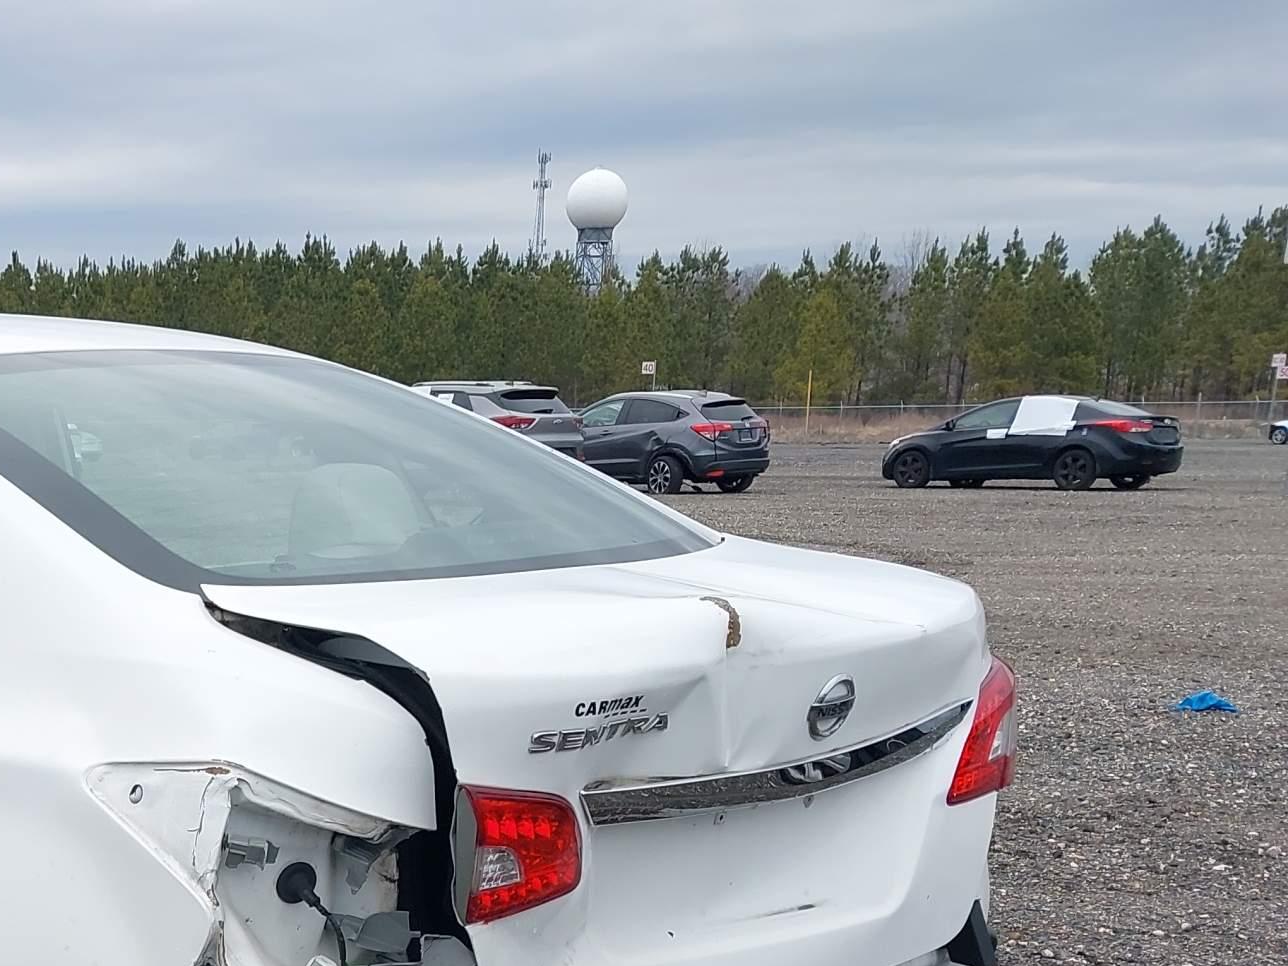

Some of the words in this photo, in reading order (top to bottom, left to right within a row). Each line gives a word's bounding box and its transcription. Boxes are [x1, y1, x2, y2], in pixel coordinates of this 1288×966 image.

[642, 363, 654, 373] 40
[817, 699, 847, 718] NISS
[527, 711, 671, 754] SENTRA
